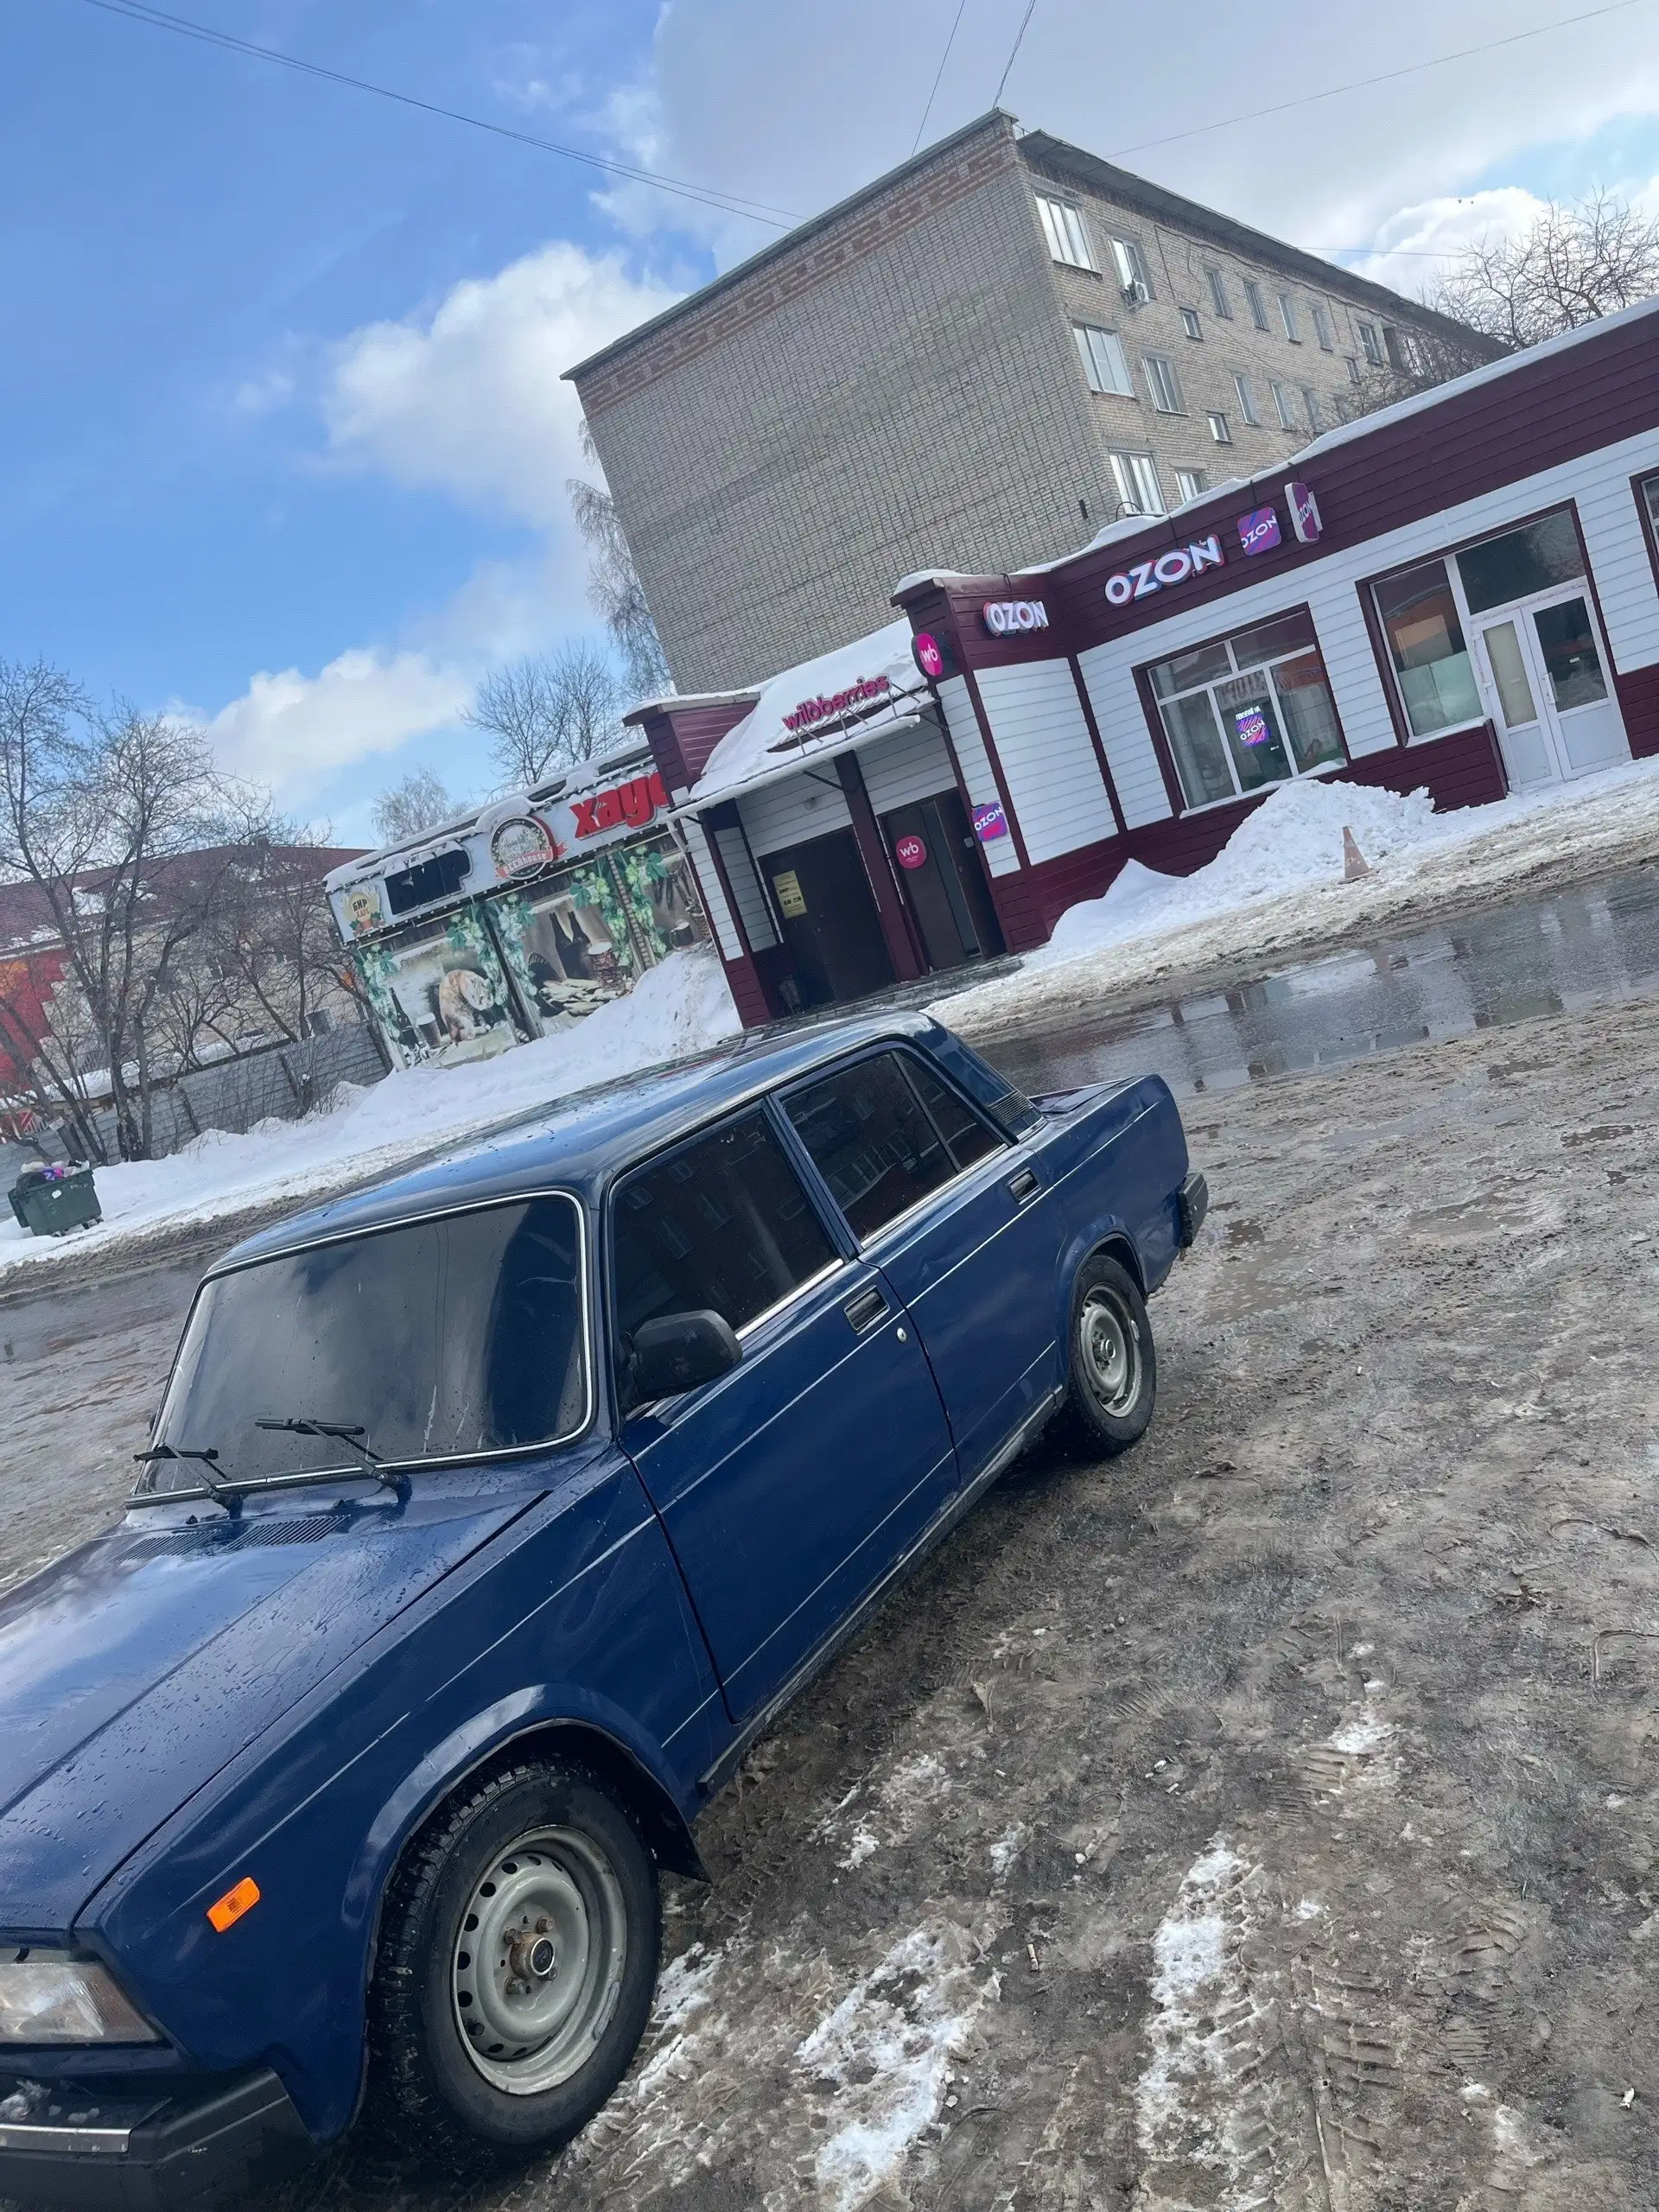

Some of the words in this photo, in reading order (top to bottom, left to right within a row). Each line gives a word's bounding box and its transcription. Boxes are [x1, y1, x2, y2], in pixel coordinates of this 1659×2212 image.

[1241, 516, 1276, 549] OZON
[1105, 533, 1224, 605] OZON
[986, 601, 1049, 633] OZON
[920, 643, 938, 663] wb
[781, 675, 891, 731] wildberries
[1240, 720, 1265, 741] OZON
[974, 806, 1002, 831] OZON
[899, 842, 919, 857] wb
[353, 899, 367, 912] БИР
